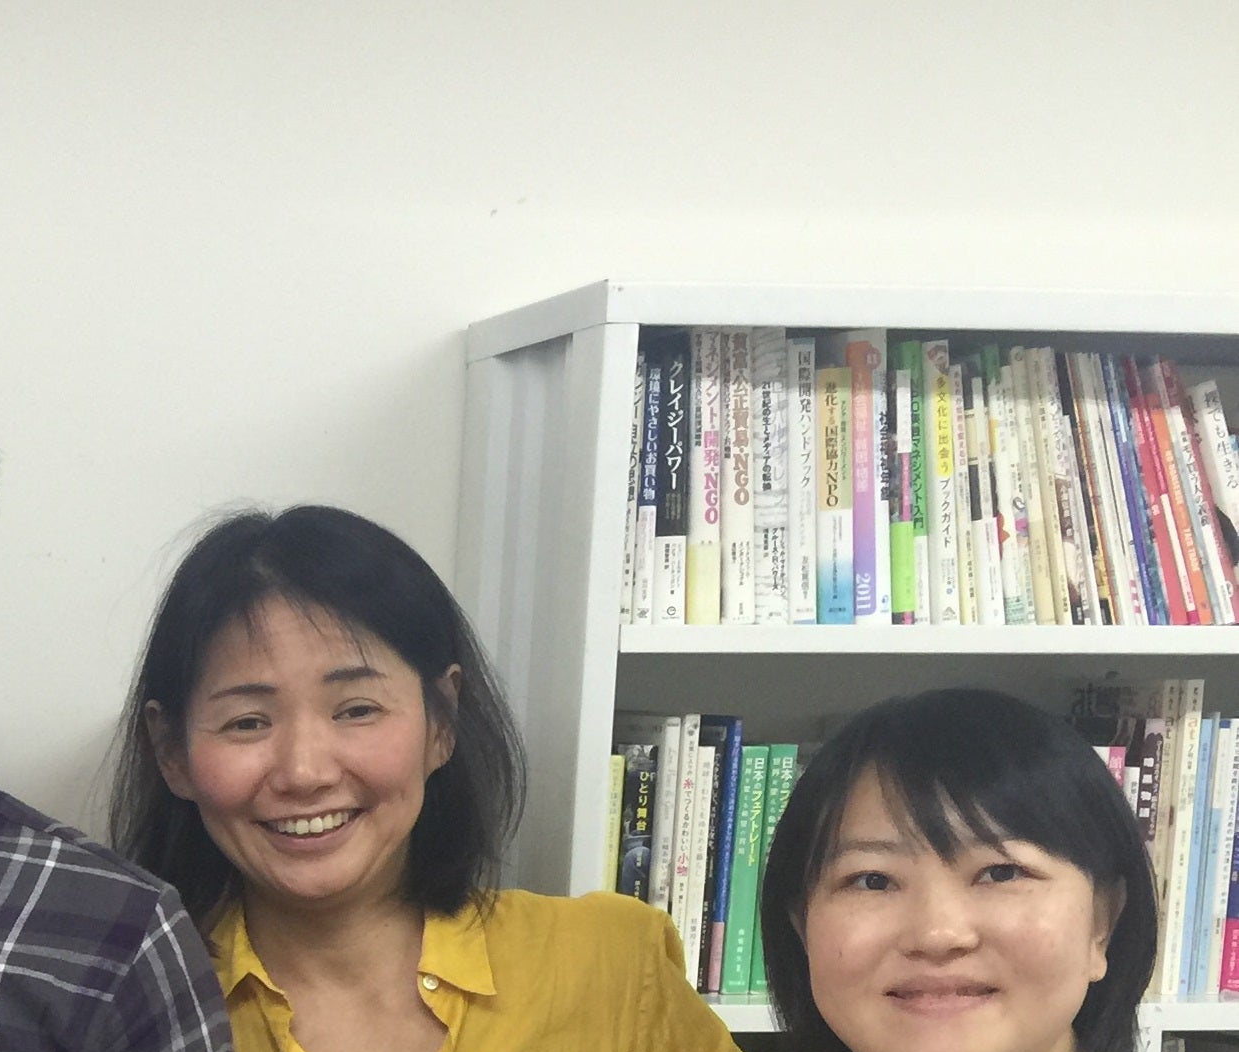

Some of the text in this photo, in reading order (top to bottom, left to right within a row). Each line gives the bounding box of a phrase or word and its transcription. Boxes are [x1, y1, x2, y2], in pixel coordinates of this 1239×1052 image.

[664, 358, 684, 491] クレイジーパワー
[798, 351, 812, 489] 国際開発ハンドブック
[825, 381, 839, 507] 進化する国際協力NPO
[855, 573, 871, 610] 2011
[636, 771, 649, 831] ひとり舞台
[748, 757, 765, 867] 日本のフェアトレード
